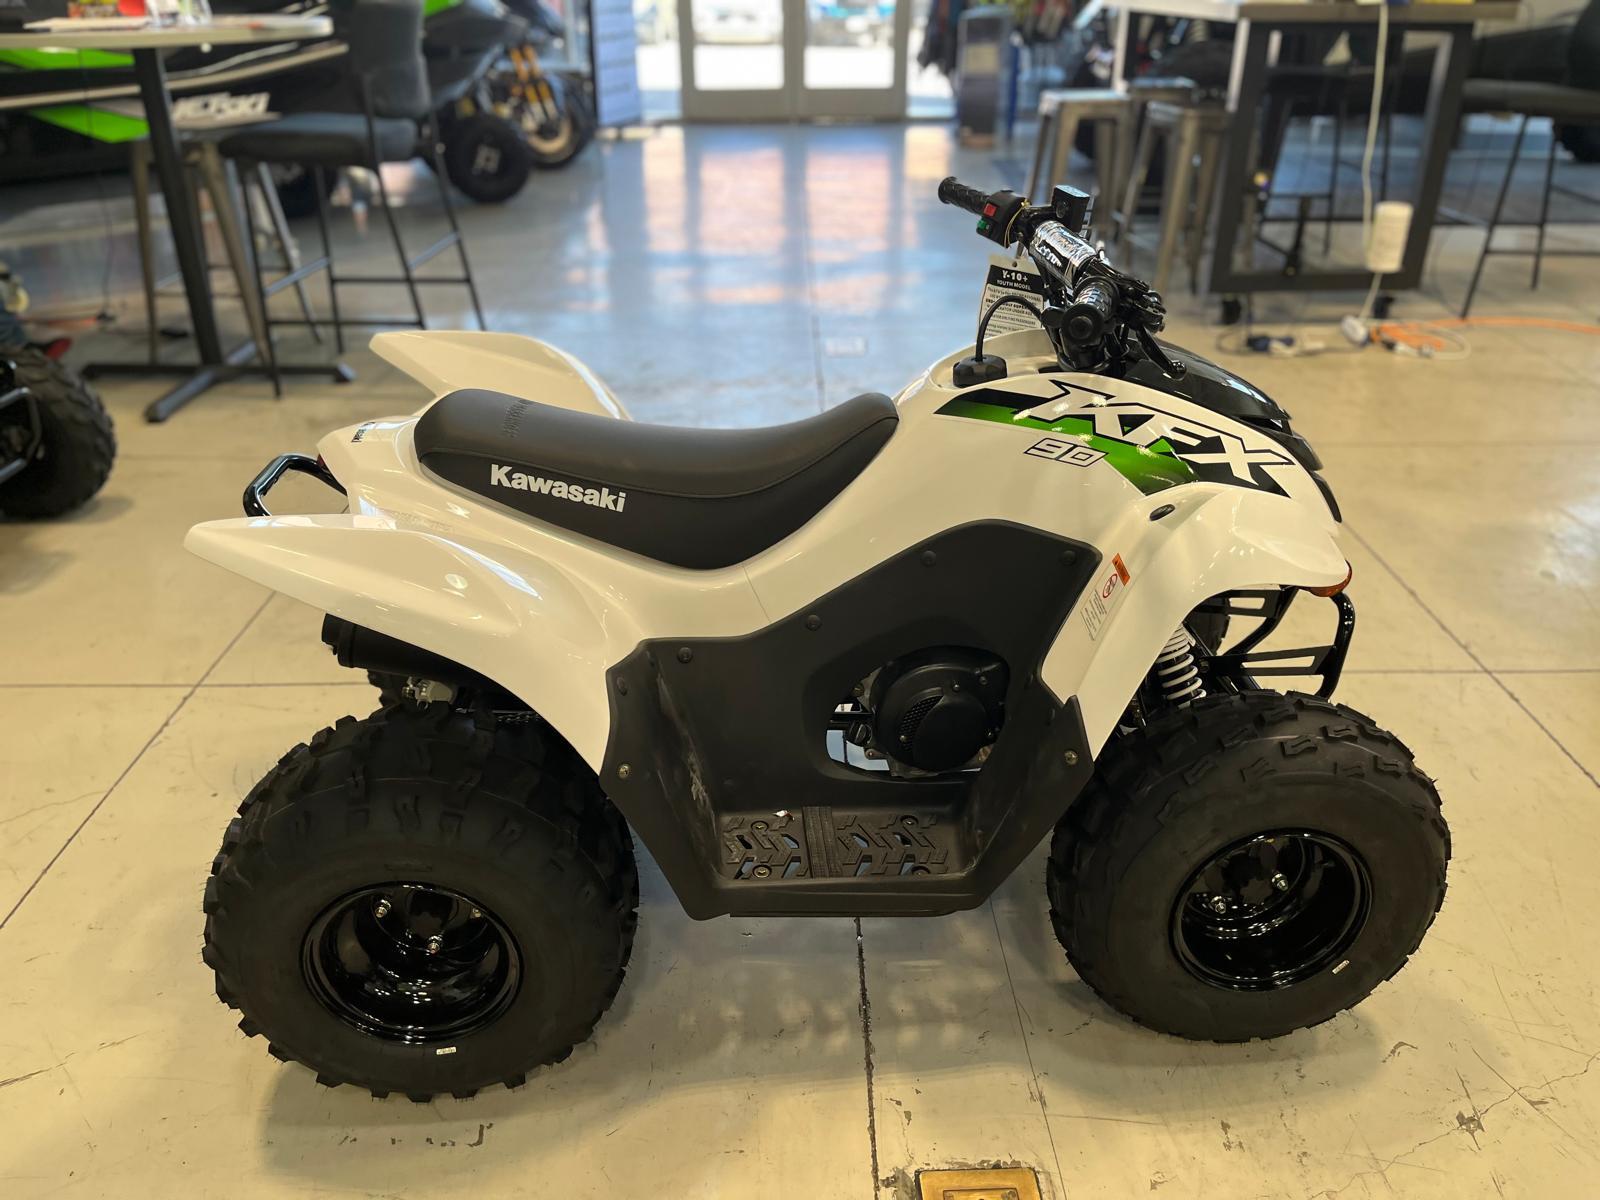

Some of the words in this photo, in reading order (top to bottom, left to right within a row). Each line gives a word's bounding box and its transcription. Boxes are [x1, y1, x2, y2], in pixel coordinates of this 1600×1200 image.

[1002, 270, 1028, 282] Y-10+
[1023, 437, 1109, 467] 90
[490, 463, 627, 513] Kawasaki
